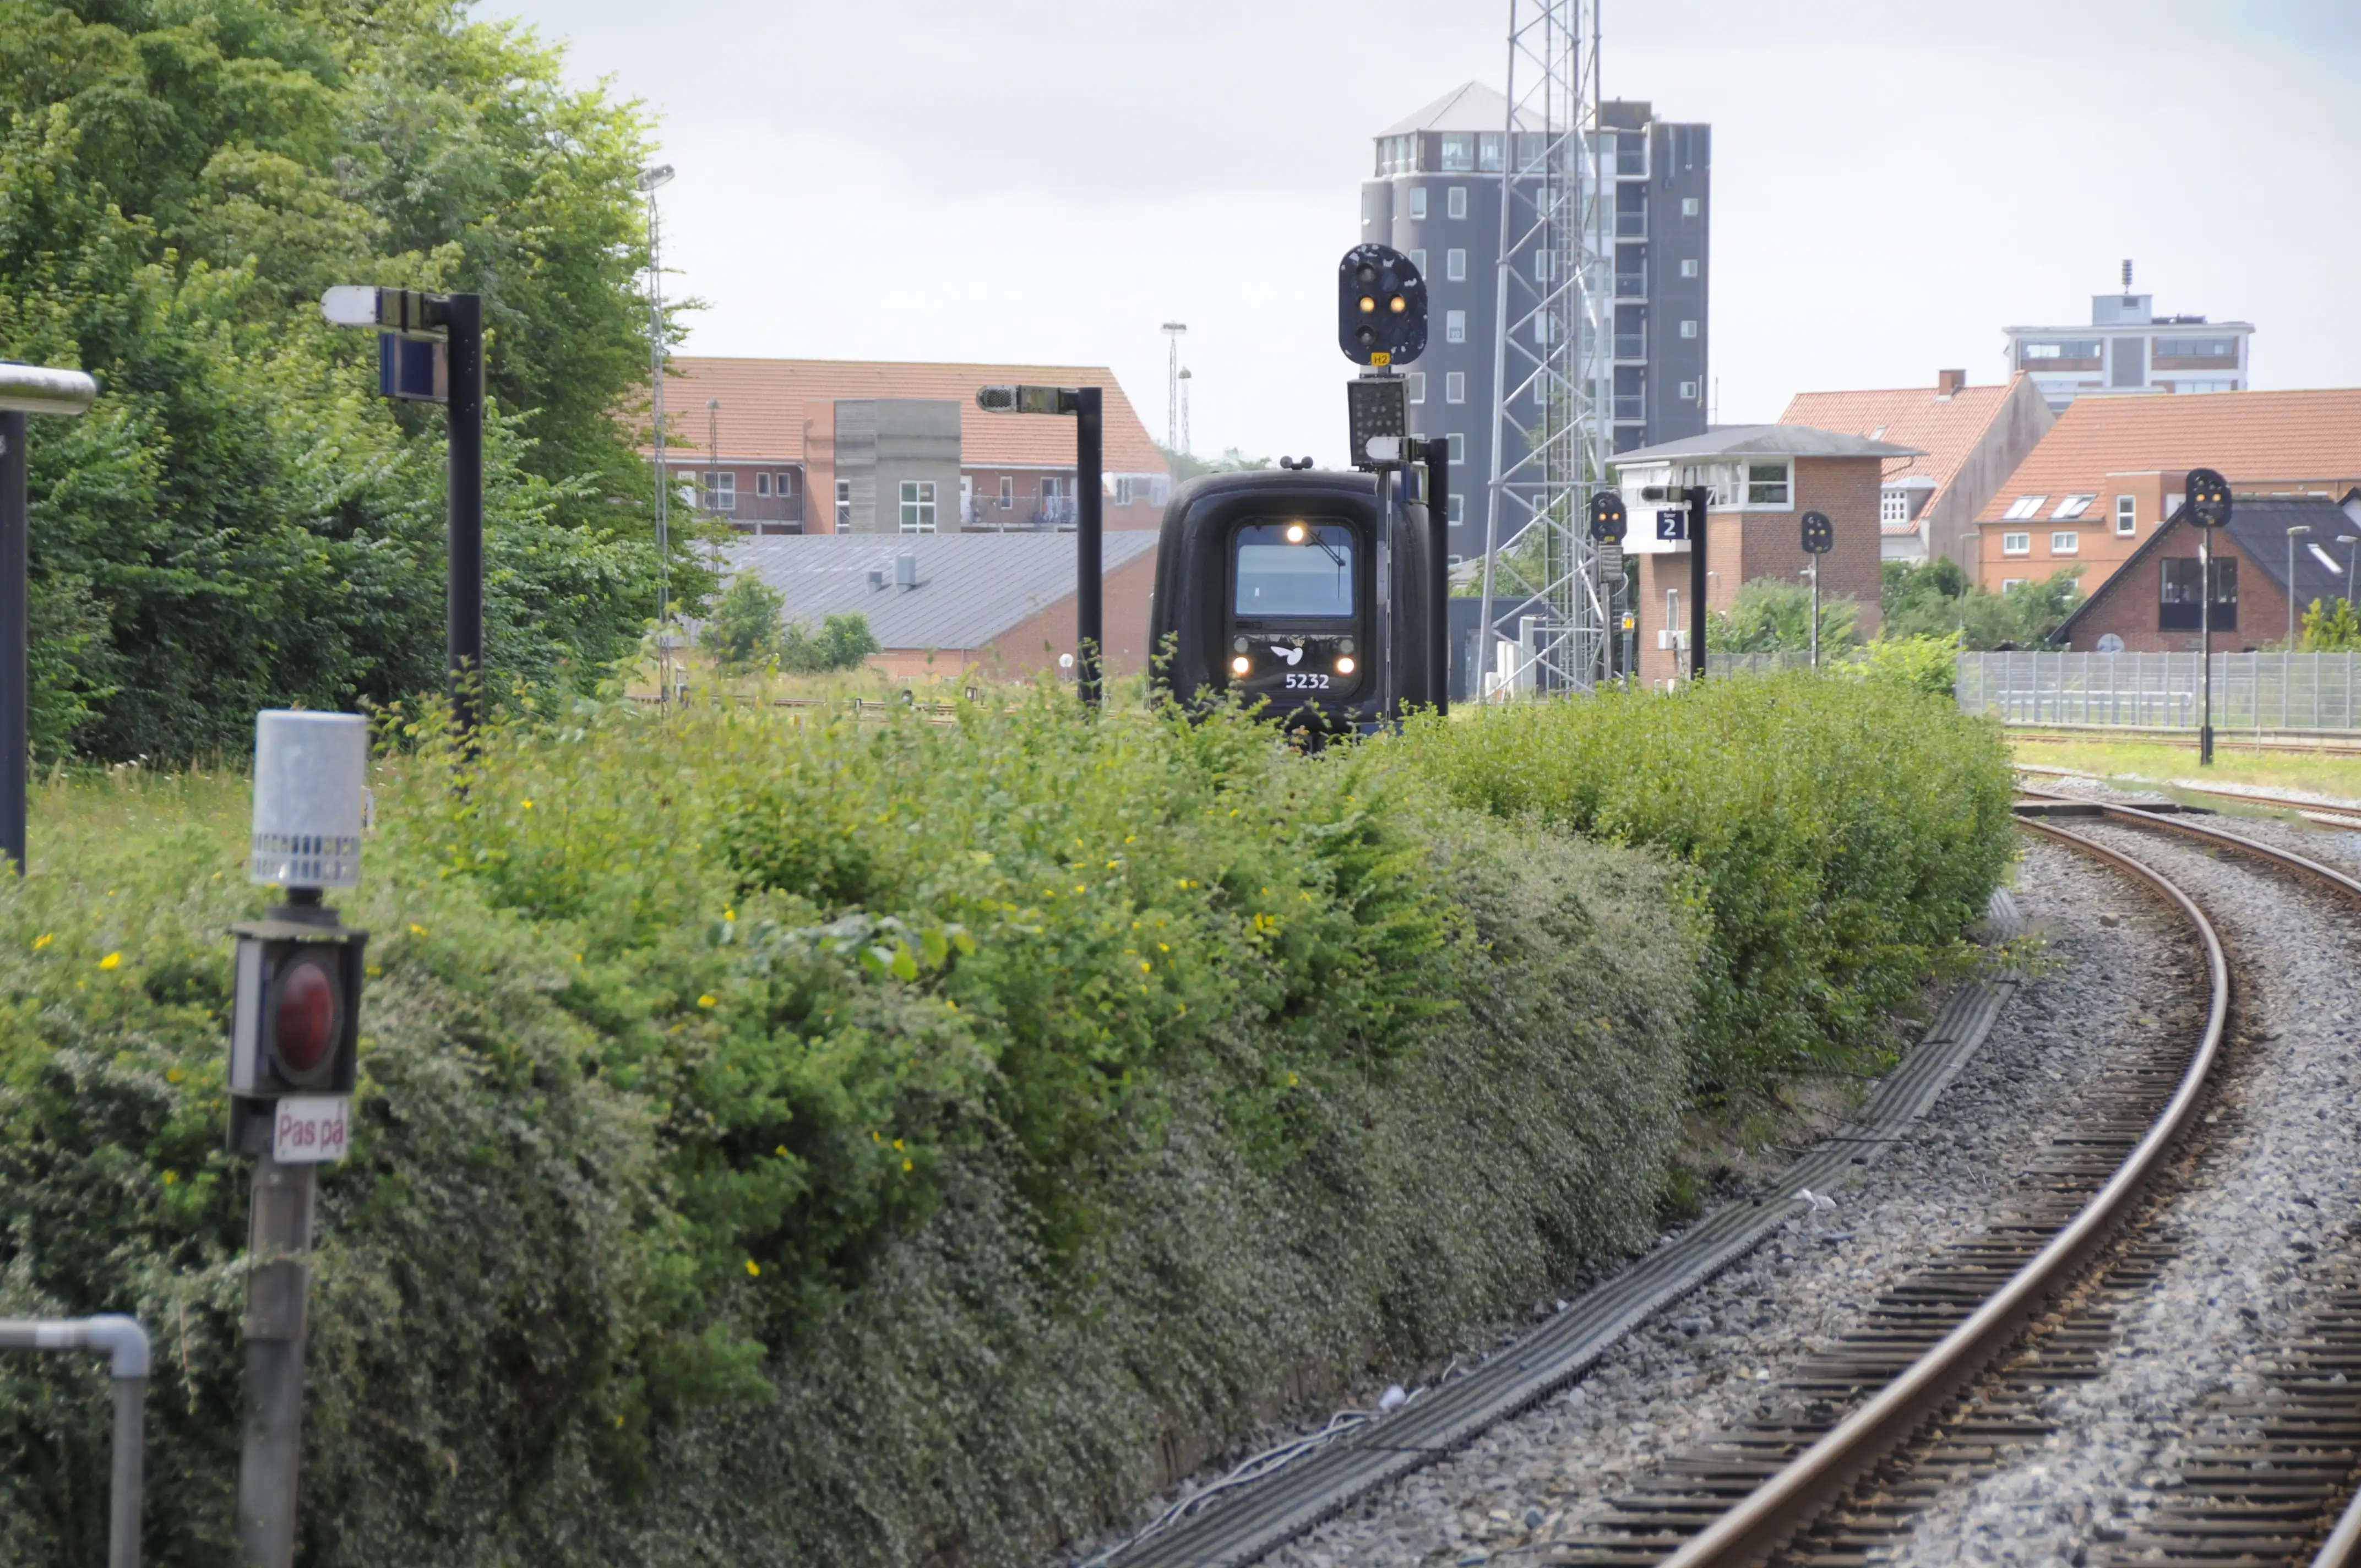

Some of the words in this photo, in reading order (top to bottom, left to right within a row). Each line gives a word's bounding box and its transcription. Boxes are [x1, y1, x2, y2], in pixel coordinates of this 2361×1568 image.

[1374, 355, 1388, 364] H2
[1664, 519, 1676, 536] 2
[1286, 673, 1330, 689] 5232
[279, 1113, 315, 1147] Pas
